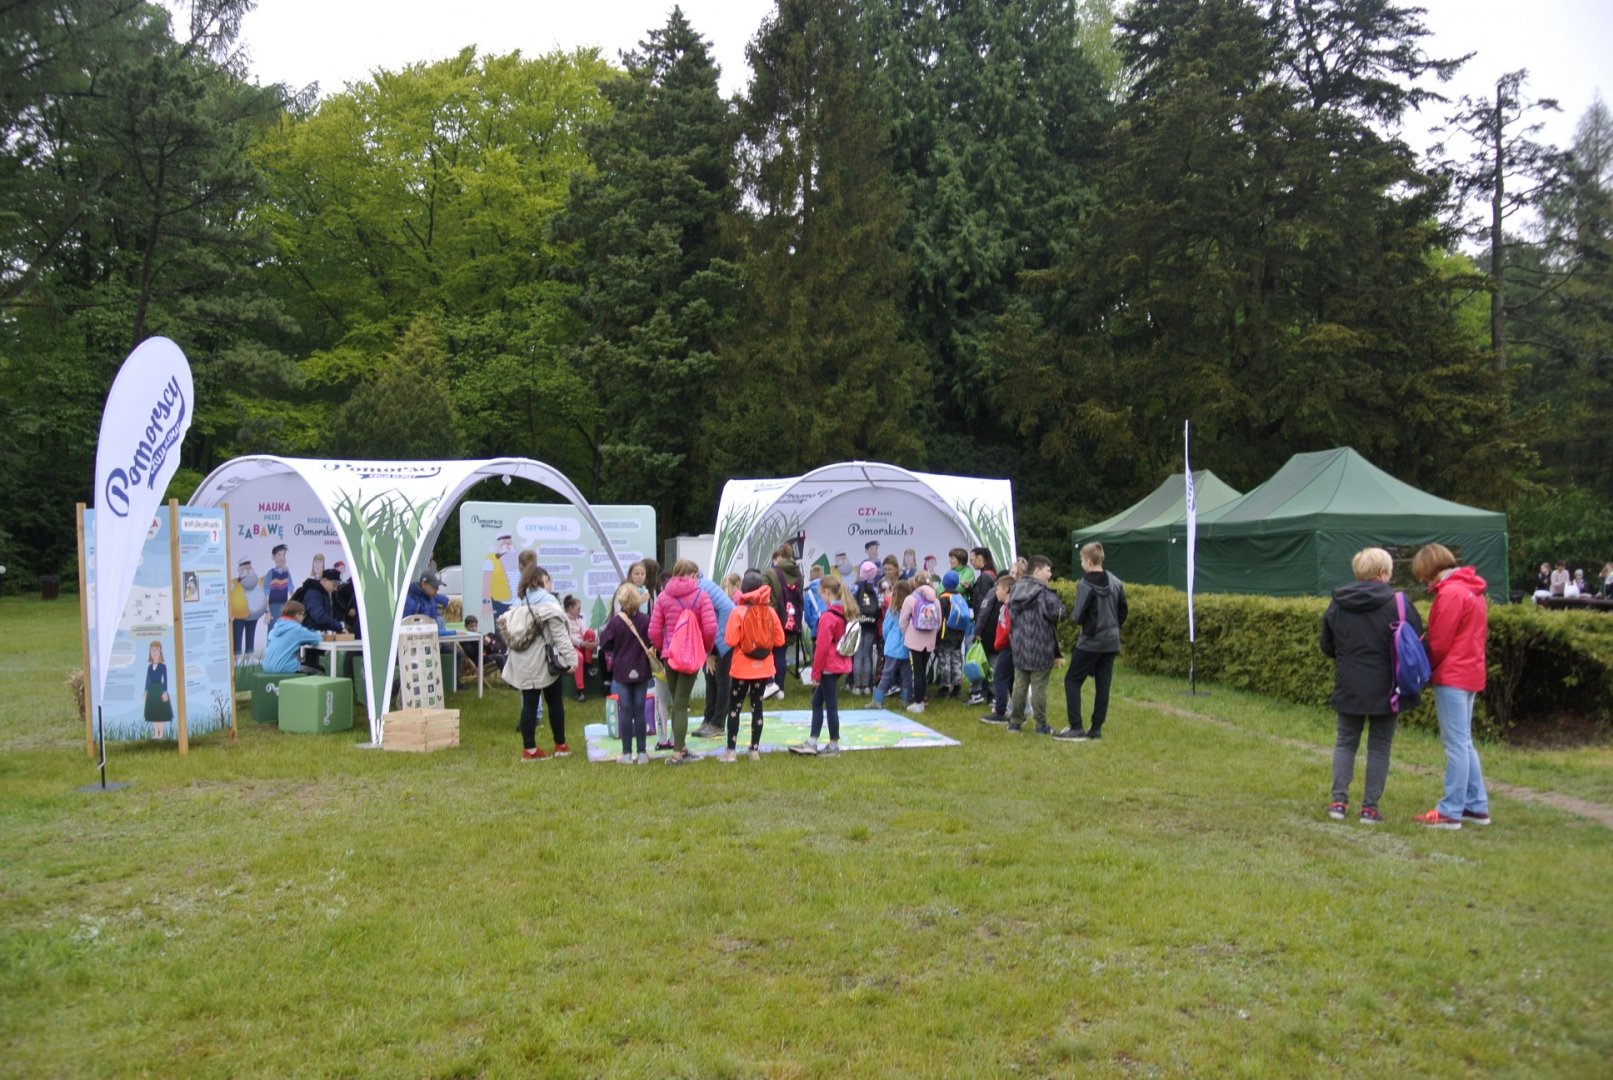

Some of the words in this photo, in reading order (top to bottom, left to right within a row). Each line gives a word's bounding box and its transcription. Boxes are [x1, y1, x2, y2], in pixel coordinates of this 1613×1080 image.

[105, 375, 185, 518] Pomorscy
[258, 502, 291, 513] NAUKA
[858, 507, 877, 516] CZY
[238, 523, 285, 540] ZABAWĘ
[293, 523, 339, 537] Pomorskic
